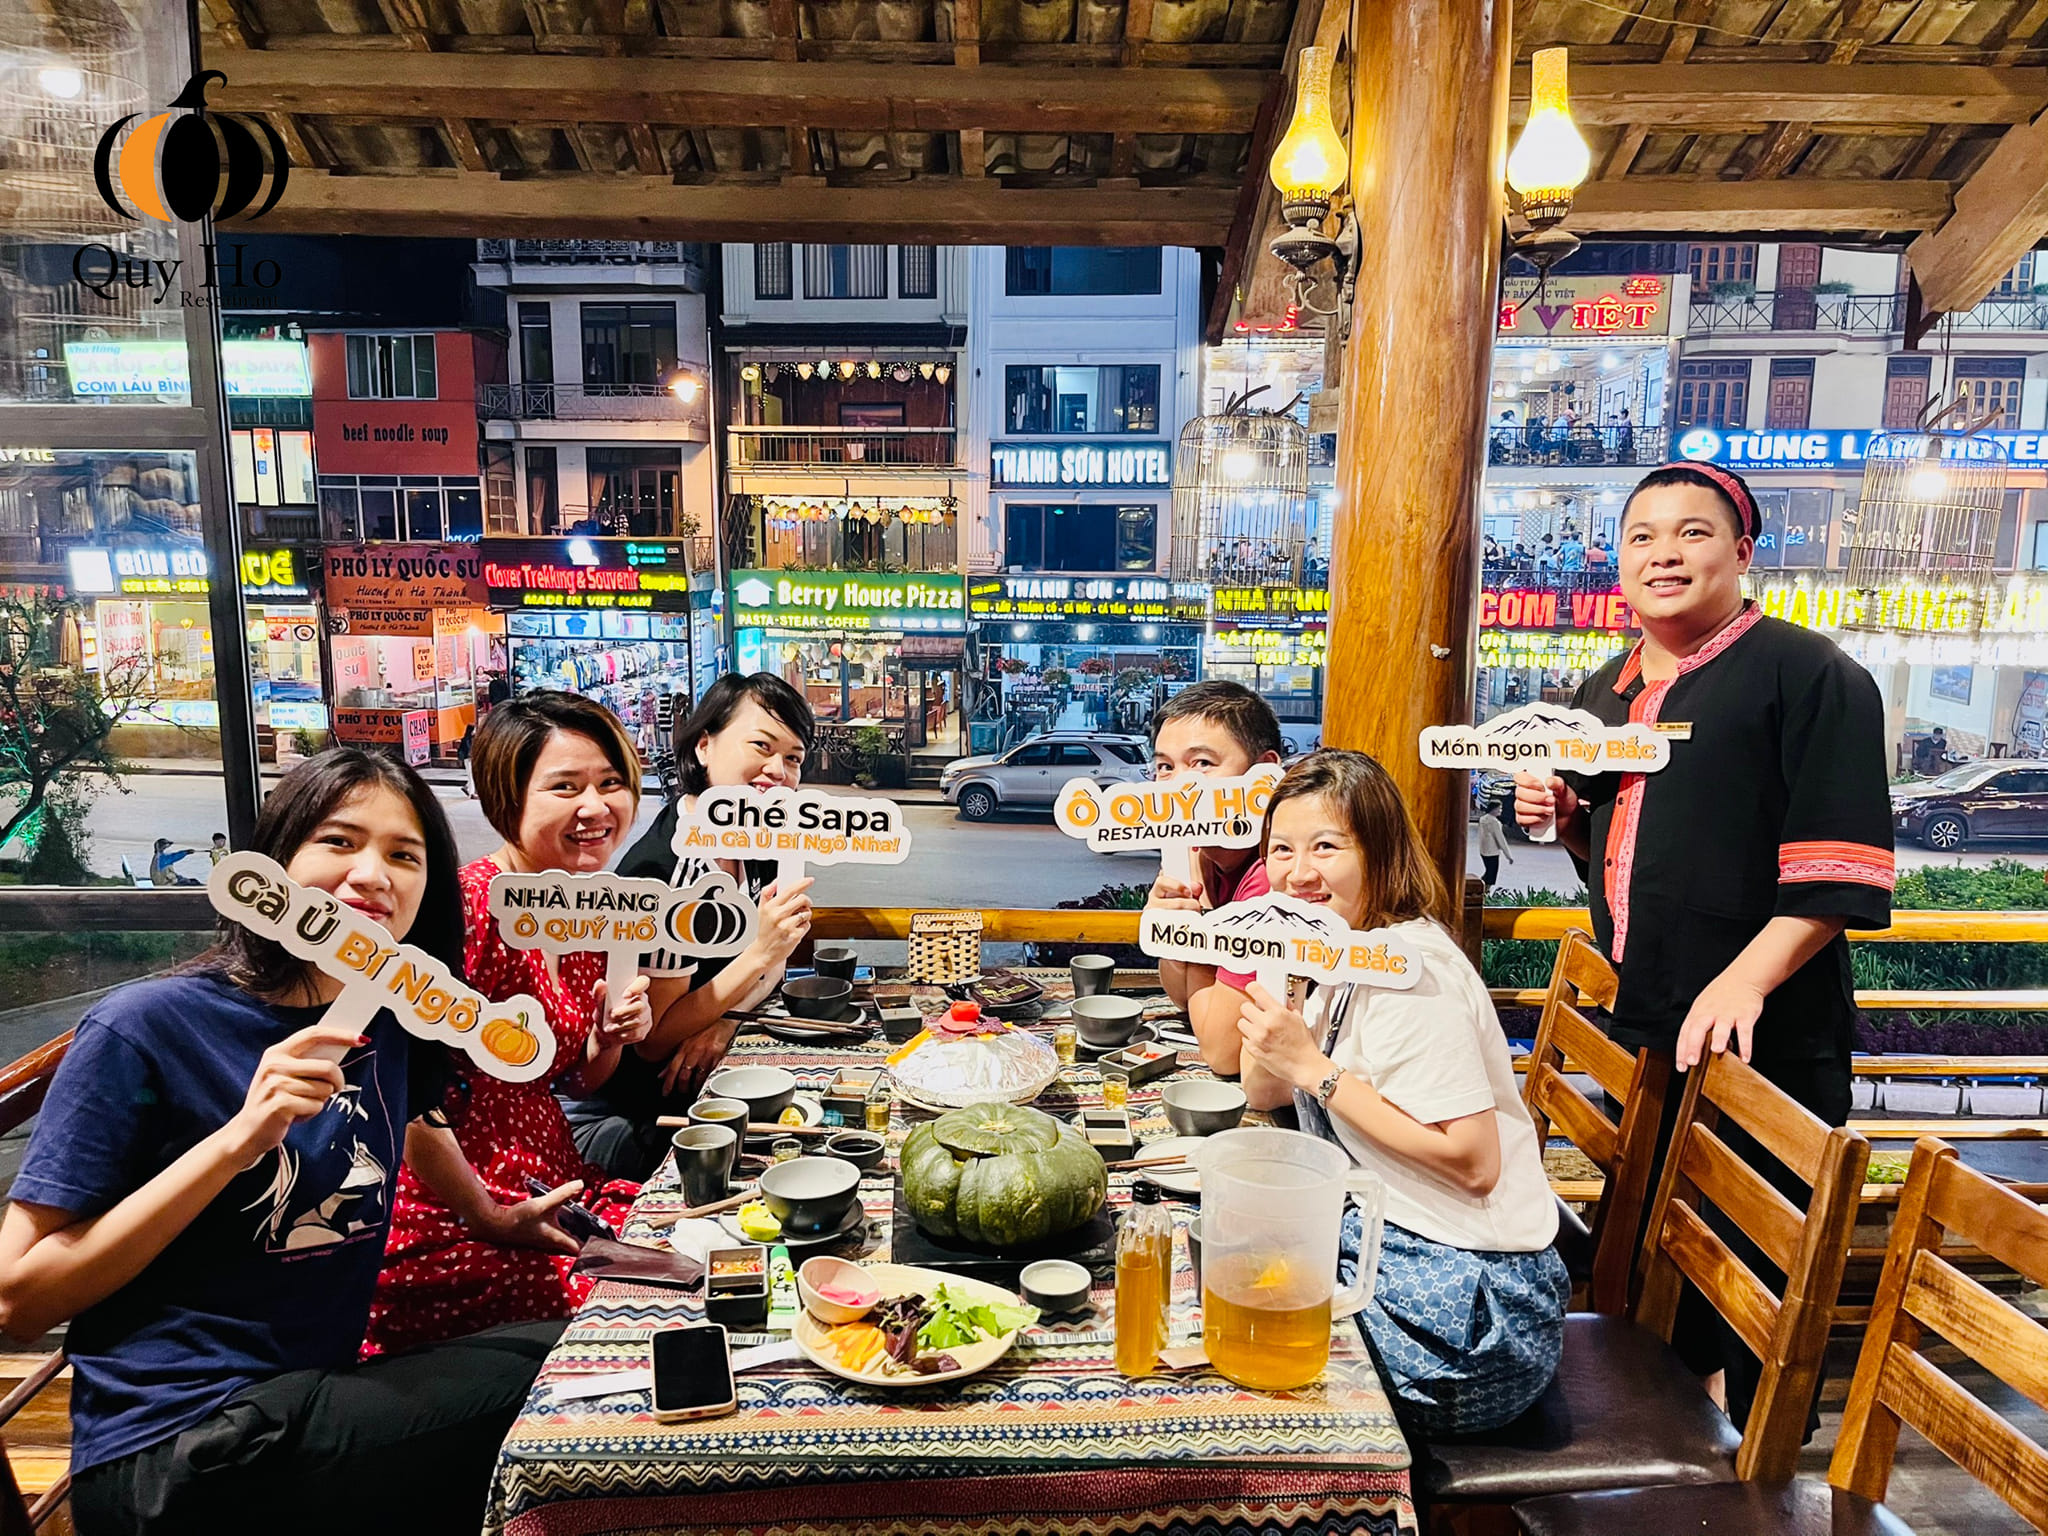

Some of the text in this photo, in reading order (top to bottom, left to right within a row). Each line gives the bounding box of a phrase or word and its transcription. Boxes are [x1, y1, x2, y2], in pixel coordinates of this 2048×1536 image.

[1533, 296, 1657, 335] VIỆT
[342, 423, 449, 446] beef noodle soup
[1725, 430, 1828, 460] TÙNG
[1939, 435, 2048, 461] HOTE
[991, 448, 1169, 484] THANH SƠN HOTEL
[240, 550, 295, 586] UẾ
[330, 548, 481, 582] PHỞ LÝ QUỐC SƯ
[484, 565, 522, 588] Clover
[522, 565, 576, 595] Trekking
[576, 572, 586, 589] &
[587, 566, 640, 591] Souvenir
[522, 594, 563, 605] MADE
[566, 595, 583, 605] IN
[617, 596, 653, 607] NAM
[777, 580, 839, 611] Berry
[844, 583, 903, 609] House
[906, 584, 963, 609] Pizza
[1006, 579, 1069, 600] THANH
[1074, 580, 1113, 600] SƠN
[1126, 580, 1168, 601] ANH
[350, 610, 369, 621] PHỞ
[737, 613, 775, 627] PASTA
[780, 615, 819, 628] STEAK
[825, 615, 871, 628] COFFEE
[1255, 650, 1291, 666] RAU
[337, 711, 361, 725] PHỞ
[366, 712, 379, 726] LÝ
[383, 714, 403, 728] QU
[1431, 735, 1657, 763] Món ngon Tây Bắc
[1066, 773, 1278, 828] Ô QUÝ HỒ
[707, 797, 892, 838] Ghé Sapa
[1097, 821, 1223, 843] RESTAURANT
[720, 829, 750, 848] Gà
[777, 831, 801, 850] Bí
[803, 833, 847, 854] Ngô
[851, 835, 902, 853] Nha!
[504, 884, 660, 913] NHÀ HÀNG
[513, 912, 657, 943] Ô QUÝ HỒ
[227, 869, 482, 1034] Gà Ủ Bí Ngô
[1151, 920, 1408, 976] Món ngon Tây Bắc
